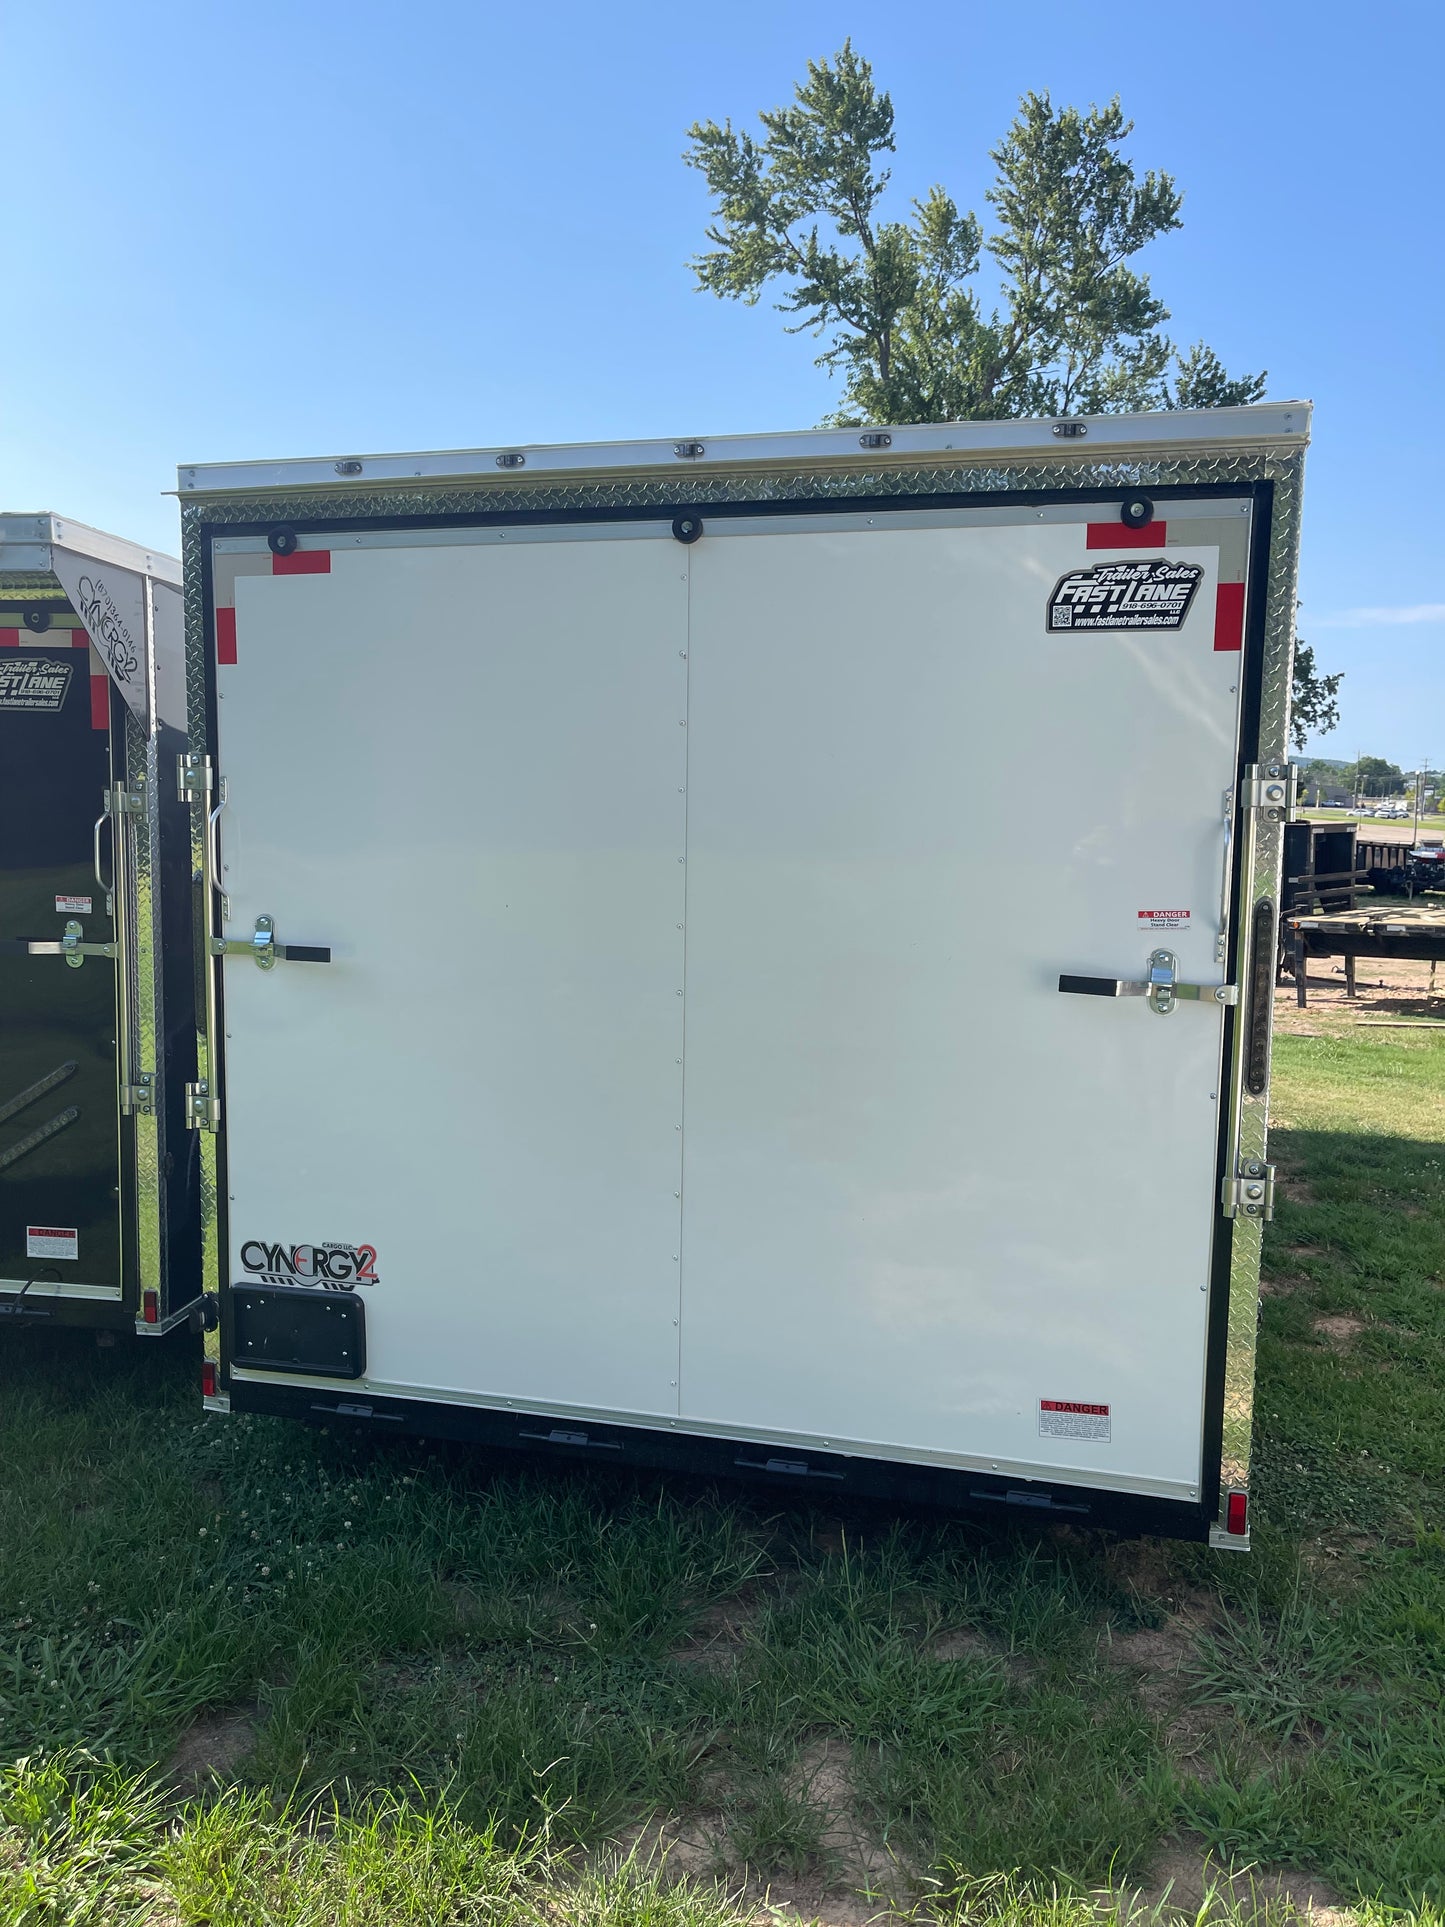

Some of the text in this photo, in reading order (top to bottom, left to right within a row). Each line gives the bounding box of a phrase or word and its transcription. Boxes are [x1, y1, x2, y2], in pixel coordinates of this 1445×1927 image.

[1096, 566, 1198, 584] Trailer Sales
[1122, 602, 1182, 610] 918-696-0701
[1074, 614, 1180, 627] www.fastlanetrailersales.com
[2, 662, 70, 674] Trailer Sales
[322, 1242, 353, 1251] CARGO LLC
[1055, 1402, 1107, 1416] DANGER
